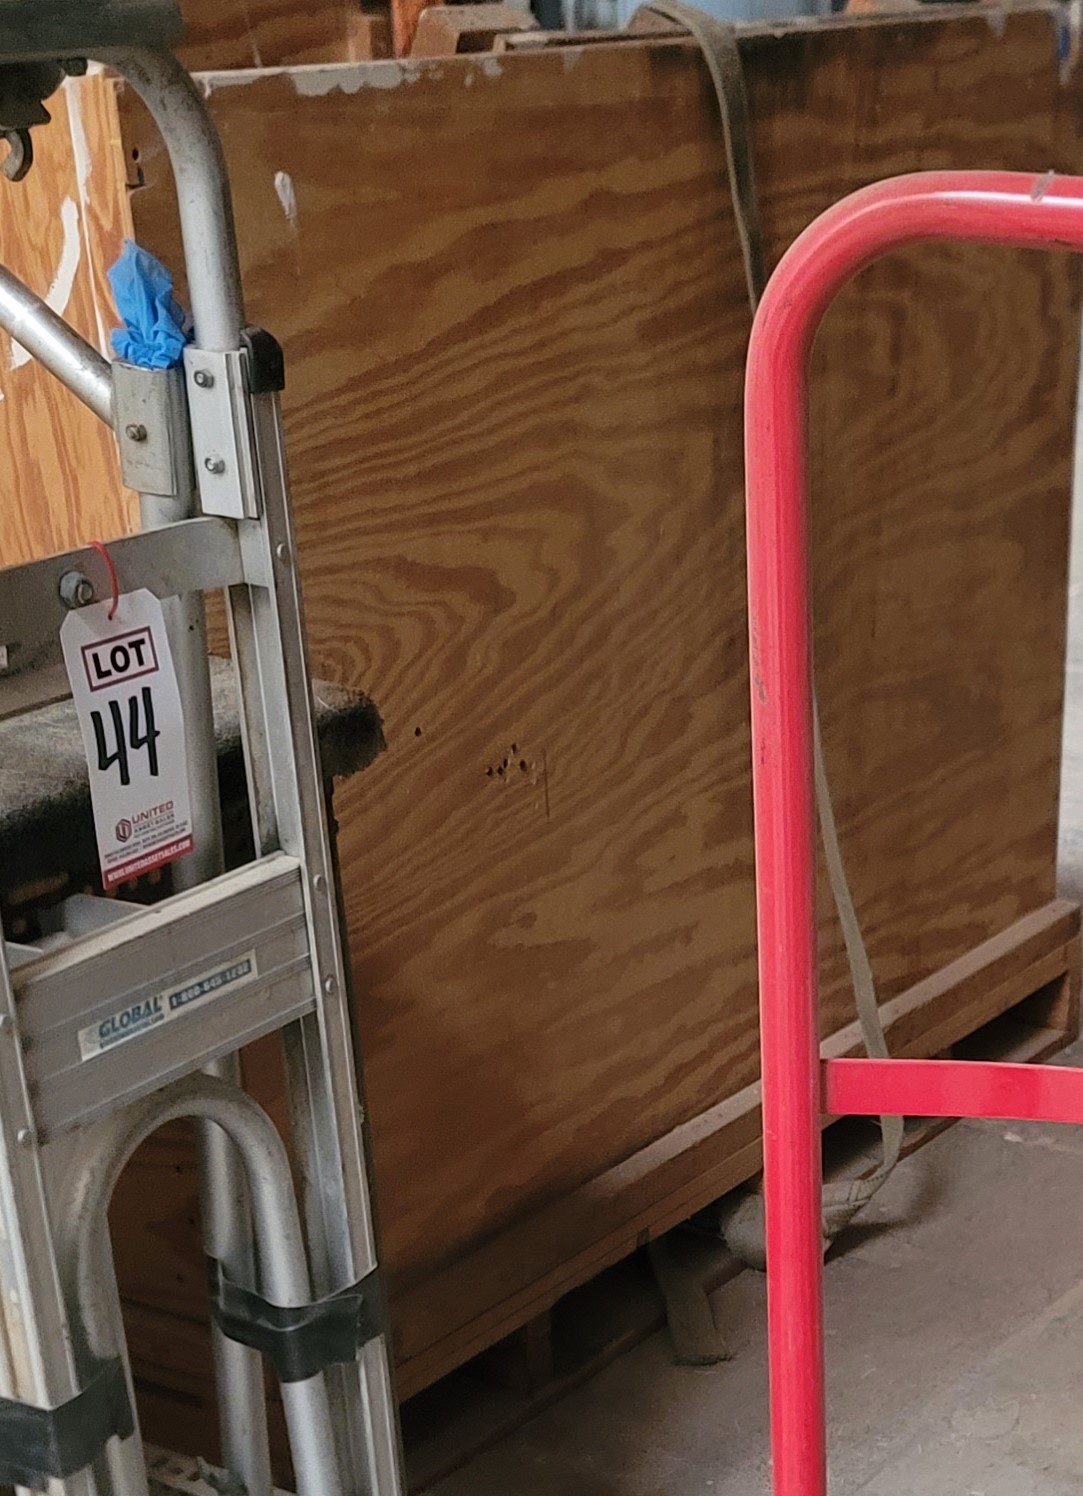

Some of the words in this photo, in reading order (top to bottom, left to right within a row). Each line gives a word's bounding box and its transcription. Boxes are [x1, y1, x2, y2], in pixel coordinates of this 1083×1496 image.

[92, 637, 147, 680] LOT
[90, 686, 161, 786] 44
[131, 800, 174, 824] UNITED
[98, 996, 163, 1039] GLOBAL
